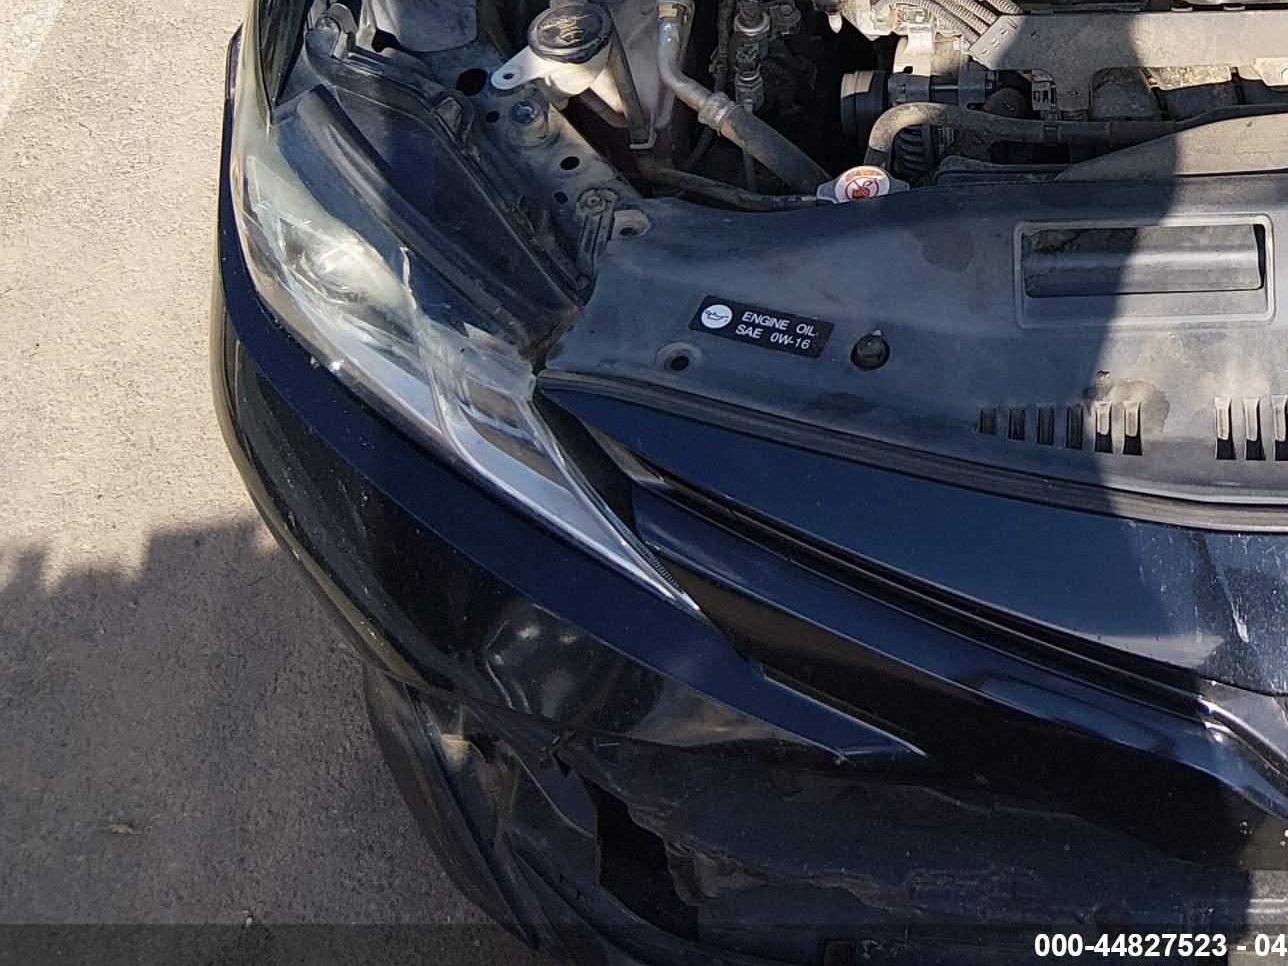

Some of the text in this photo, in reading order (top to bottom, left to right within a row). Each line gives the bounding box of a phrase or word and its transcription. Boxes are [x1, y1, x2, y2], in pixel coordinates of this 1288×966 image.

[735, 324, 811, 350] SAE 0W-16
[741, 311, 816, 337] ENGINE OIL
